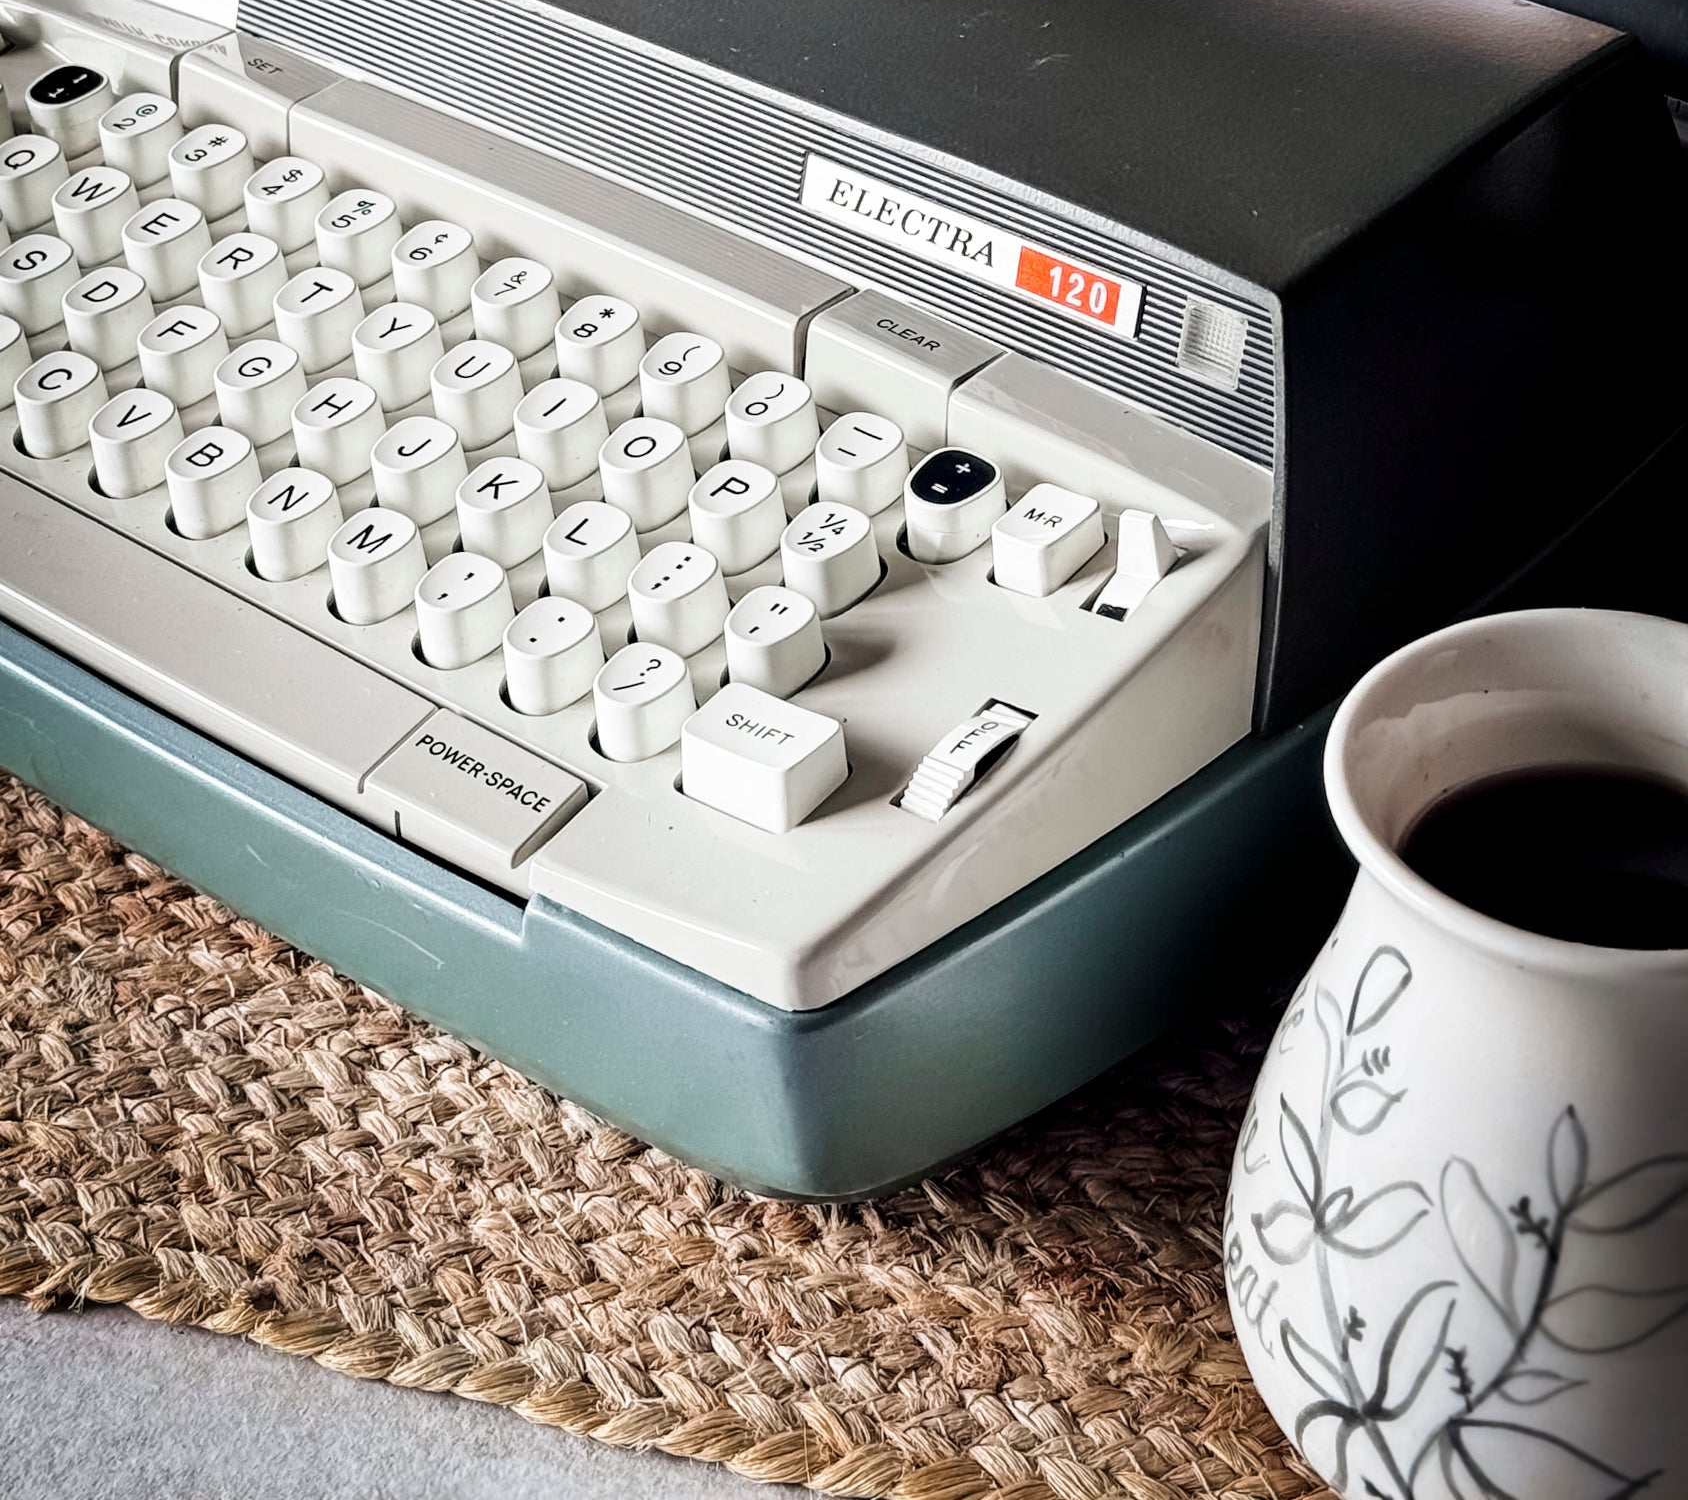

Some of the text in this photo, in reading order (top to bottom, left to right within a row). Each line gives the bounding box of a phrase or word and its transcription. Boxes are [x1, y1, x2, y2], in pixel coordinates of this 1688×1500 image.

[247, 58, 283, 75] SET
[135, 103, 159, 118] @
[112, 117, 137, 131] 2
[208, 136, 228, 148] #
[3, 149, 38, 173] Q
[184, 149, 208, 162] 3
[282, 169, 304, 183] $
[70, 176, 117, 204] W
[261, 184, 285, 196] 4
[355, 200, 376, 216] %
[140, 212, 180, 236] E
[331, 214, 357, 229] 5
[408, 247, 433, 261] 6
[826, 177, 1108, 315] ELECTRA 120
[12, 250, 48, 271] S
[216, 246, 254, 271] R
[510, 270, 528, 285] &
[81, 280, 119, 303] D
[300, 281, 334, 303] T
[494, 282, 517, 297] 7
[156, 320, 198, 338] F
[379, 317, 413, 339] Y
[572, 323, 599, 339] 8
[876, 315, 943, 352] CLEAR
[237, 356, 272, 378] G
[454, 355, 491, 379] U
[657, 361, 683, 376] 9
[37, 368, 73, 391] C
[116, 404, 153, 428] V
[310, 393, 354, 419] H
[185, 442, 224, 468] B
[397, 438, 432, 457] J
[623, 435, 657, 459] O
[476, 473, 519, 500] K
[709, 476, 750, 497] P
[267, 484, 310, 512] N
[346, 523, 393, 554] M
[564, 517, 589, 546] L
[639, 658, 662, 677] ?
[725, 713, 795, 745] SHIFT
[949, 722, 1000, 756] OFF
[415, 731, 553, 813] POWER-SPACE
